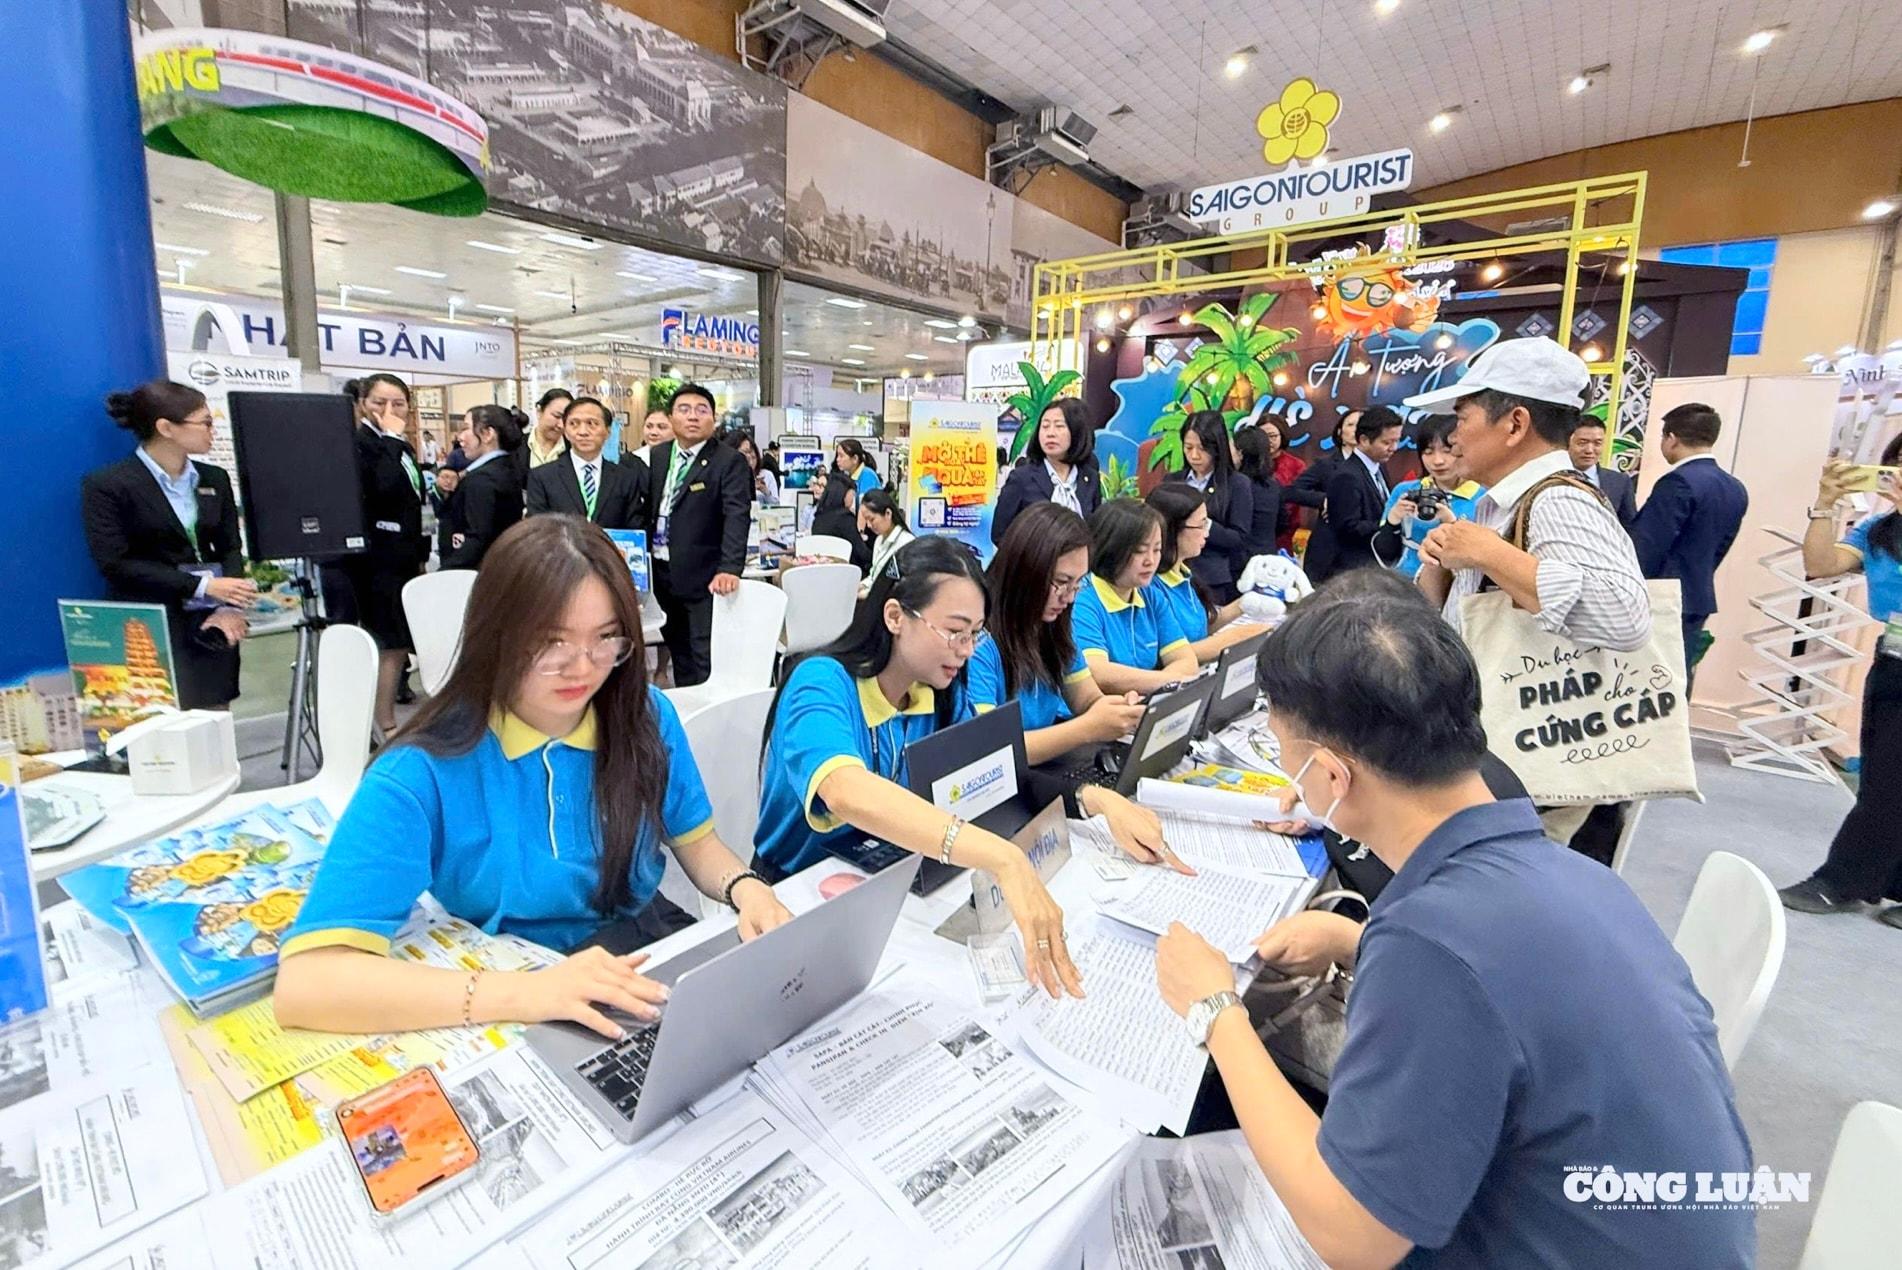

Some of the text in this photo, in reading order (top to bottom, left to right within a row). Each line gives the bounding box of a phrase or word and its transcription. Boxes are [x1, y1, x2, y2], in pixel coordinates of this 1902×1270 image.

[1190, 155, 1411, 217] SAIGONTOURIST
[1223, 196, 1364, 231] GROUP
[358, 323, 445, 361] BẢN
[661, 309, 759, 346] FLAMING
[682, 334, 758, 358] REDTOU
[475, 341, 500, 352] JNTO
[224, 366, 290, 382] SAMTRIP
[1368, 339, 1458, 397] Tượng
[1520, 646, 1583, 674] Du học
[1519, 668, 1637, 710] PHÁP cho
[1514, 687, 1677, 753] CỨNG CẤP
